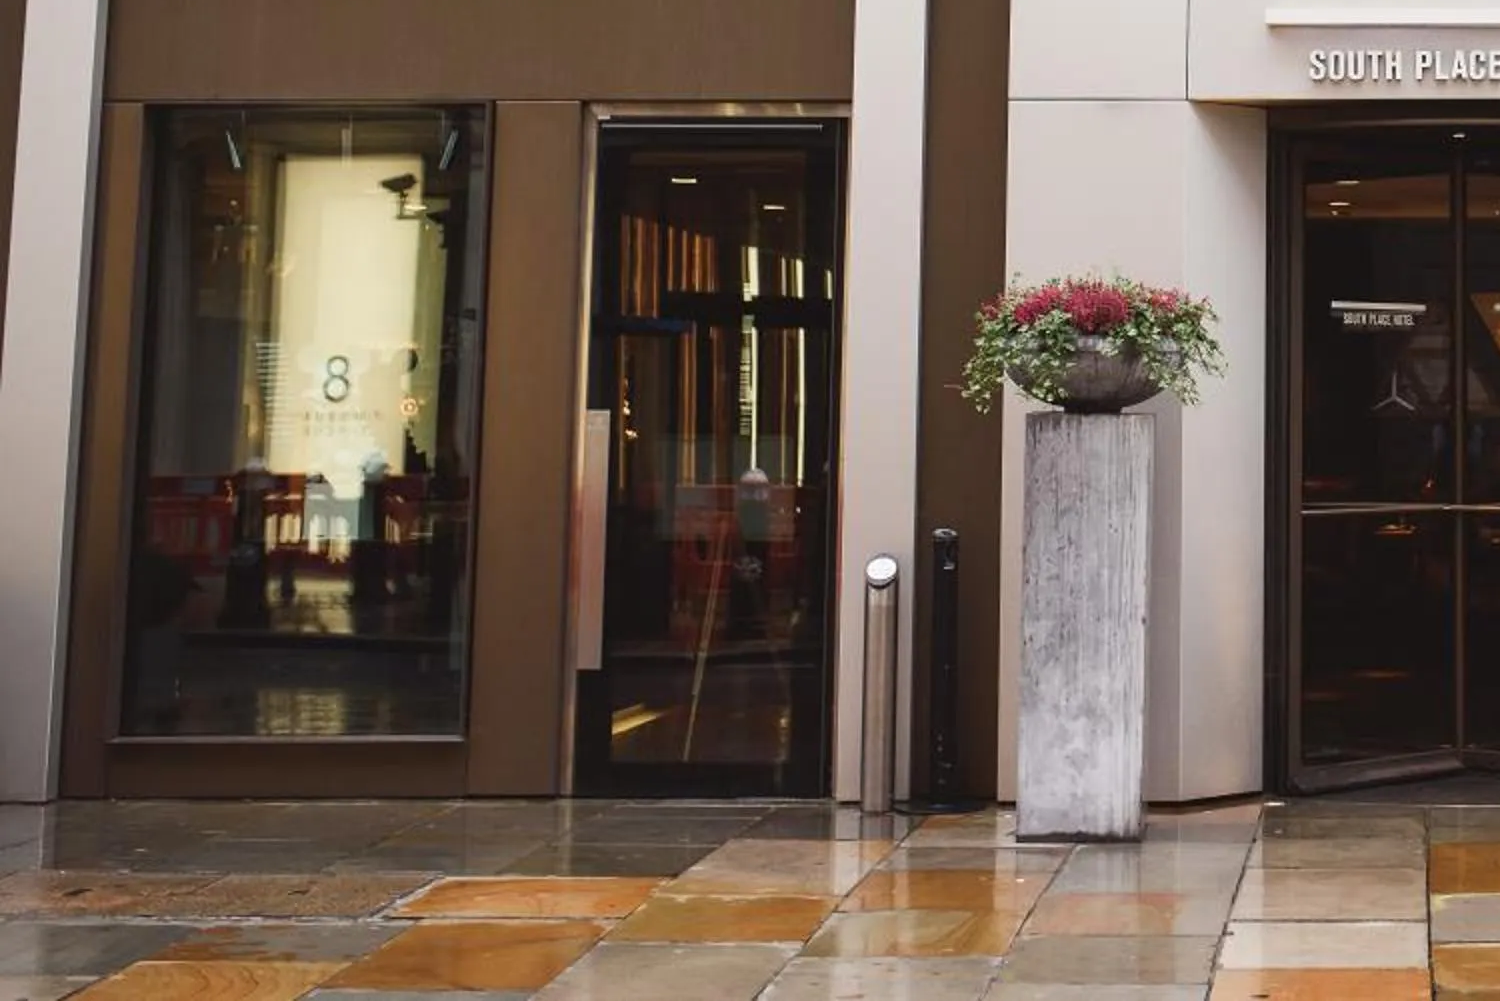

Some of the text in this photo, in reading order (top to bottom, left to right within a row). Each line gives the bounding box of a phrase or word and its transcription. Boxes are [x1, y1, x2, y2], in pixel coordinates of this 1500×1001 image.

[1309, 48, 1402, 82] SOUTH
[1369, 313, 1391, 326] PLACE
[1393, 314, 1415, 326] HOTEL
[323, 355, 350, 403] 8
